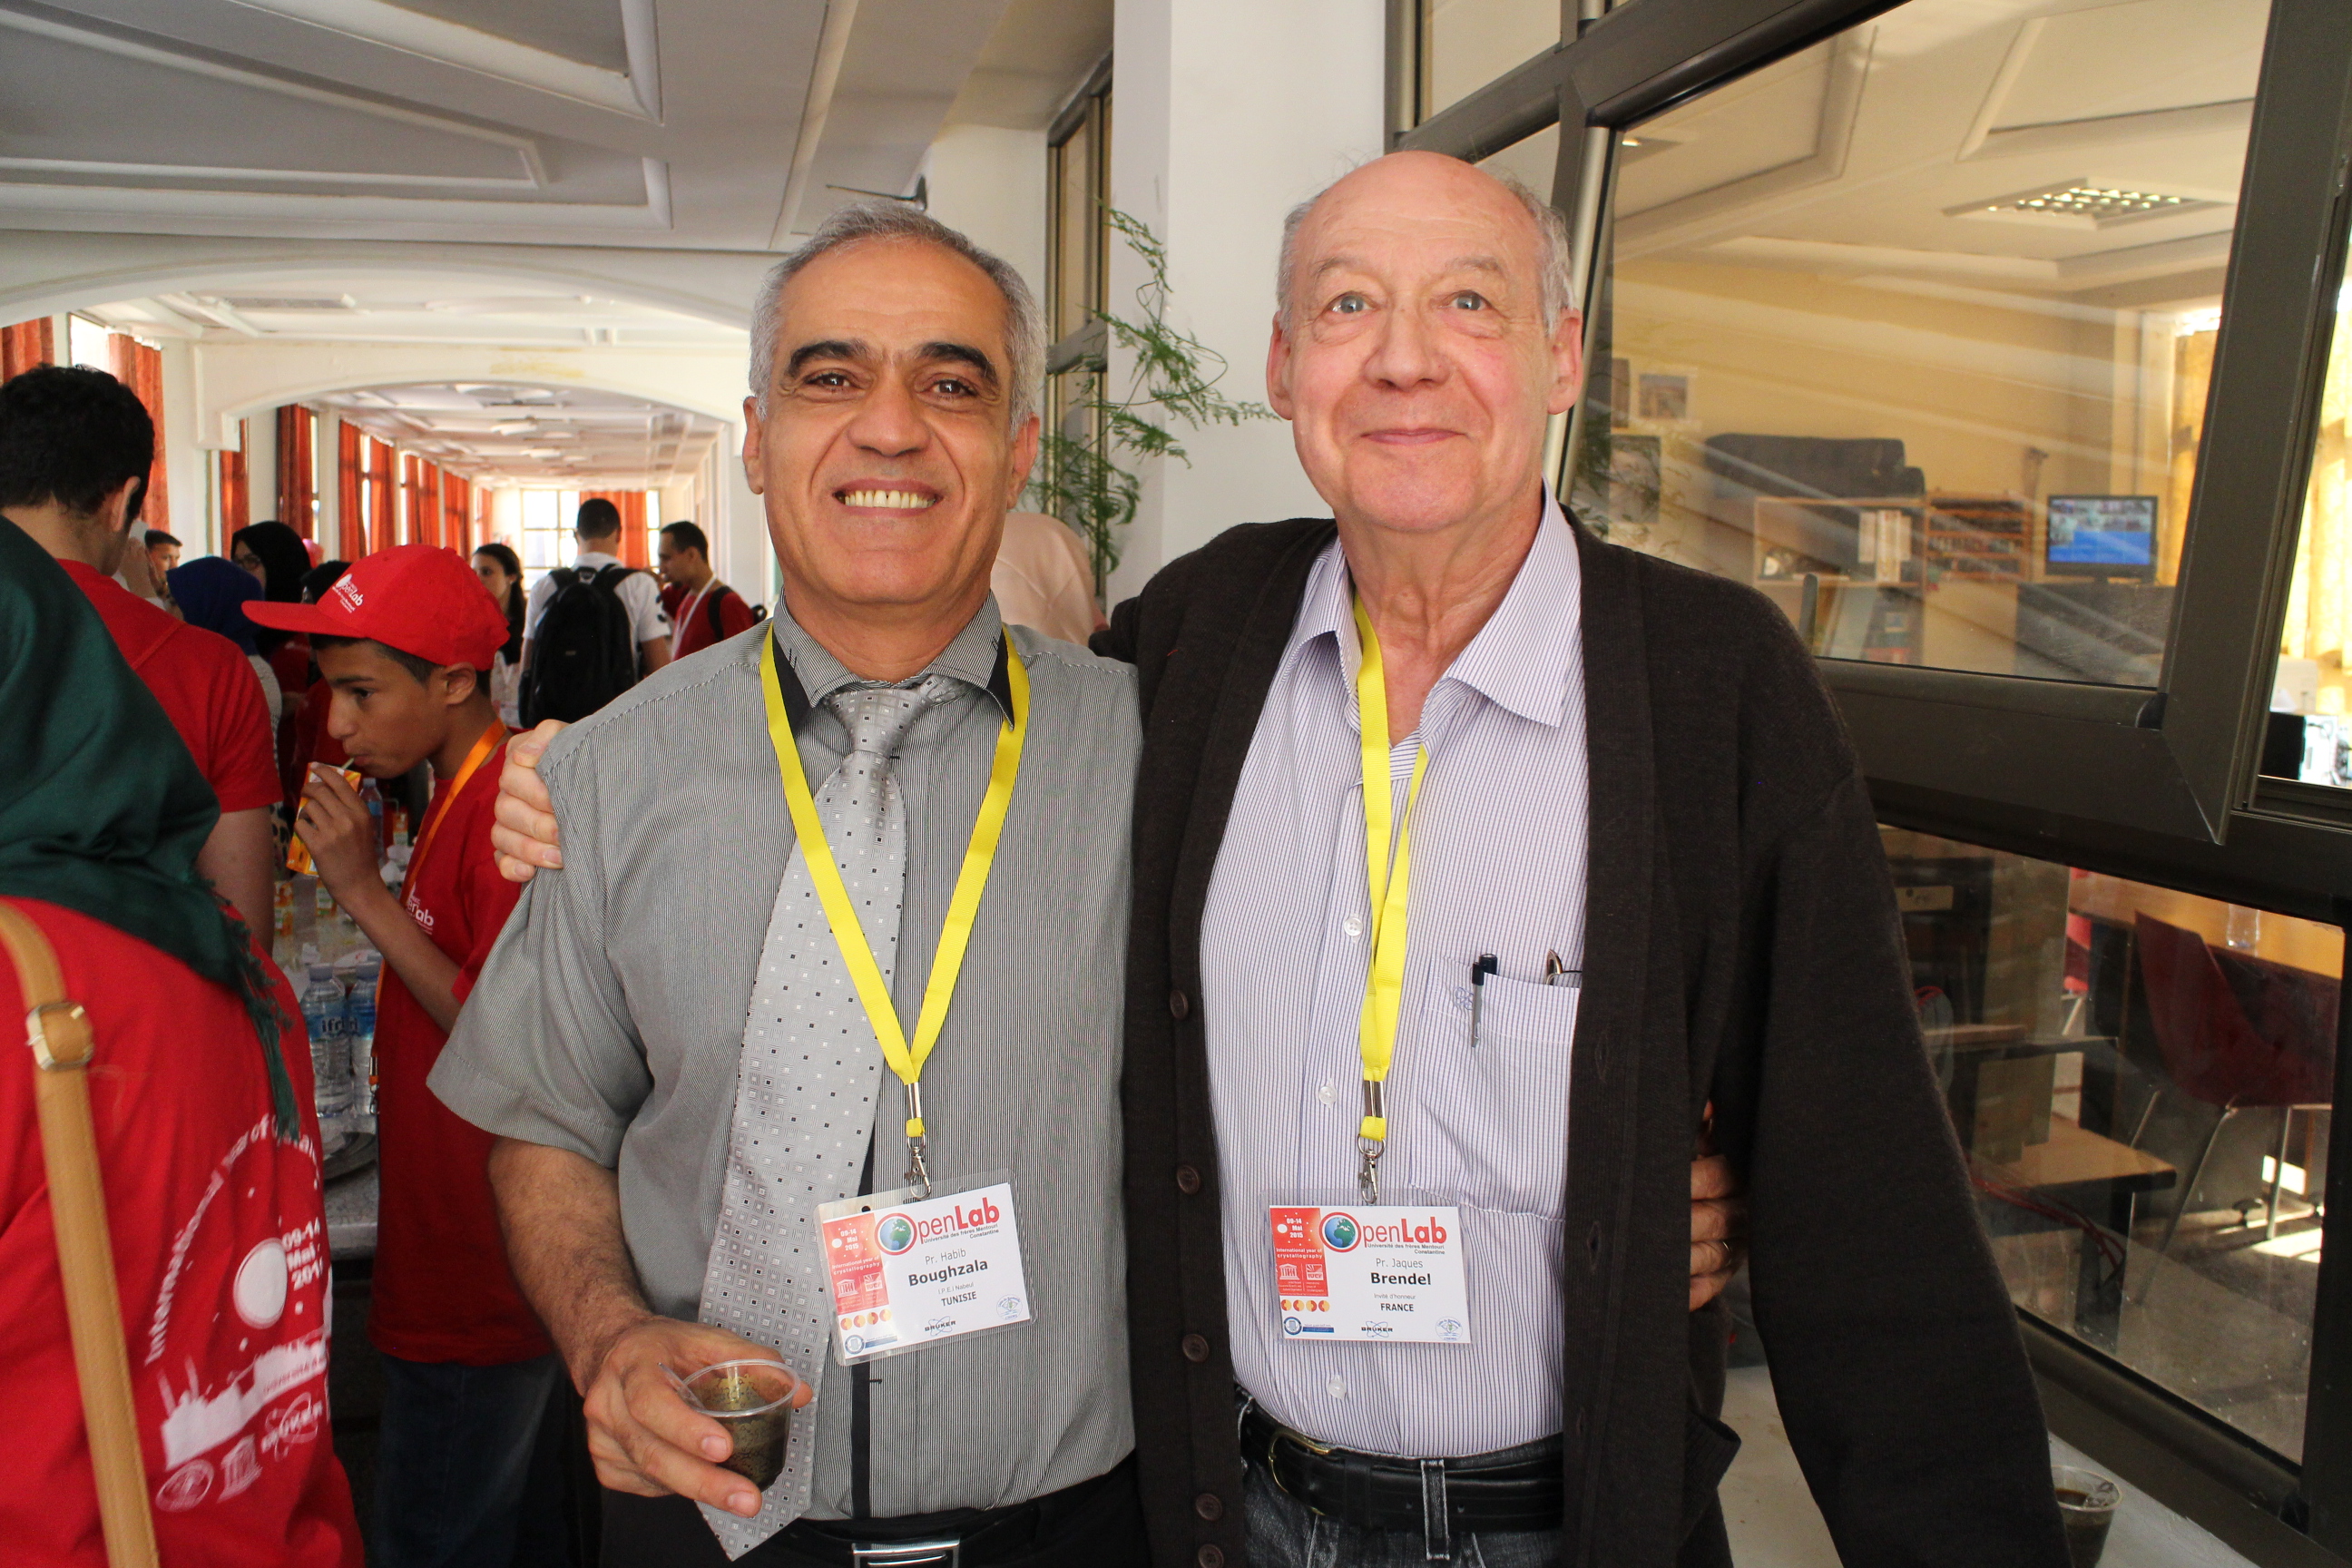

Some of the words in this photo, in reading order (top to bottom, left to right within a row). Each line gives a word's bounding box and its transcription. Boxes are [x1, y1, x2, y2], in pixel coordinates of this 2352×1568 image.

[969, 1229, 1000, 1240] Constantine
[845, 1243, 859, 1251] 2015
[926, 1255, 938, 1266] Pr.
[940, 1249, 966, 1262] Habib
[1376, 1258, 1389, 1268] Pr.
[1391, 1258, 1424, 1270] Jaques
[908, 1259, 988, 1287] Boughzala
[1370, 1272, 1431, 1285] Brendel
[941, 1291, 977, 1307] TUNISIE
[1380, 1302, 1415, 1312] FRANCE
[924, 1320, 956, 1332] BRUKER
